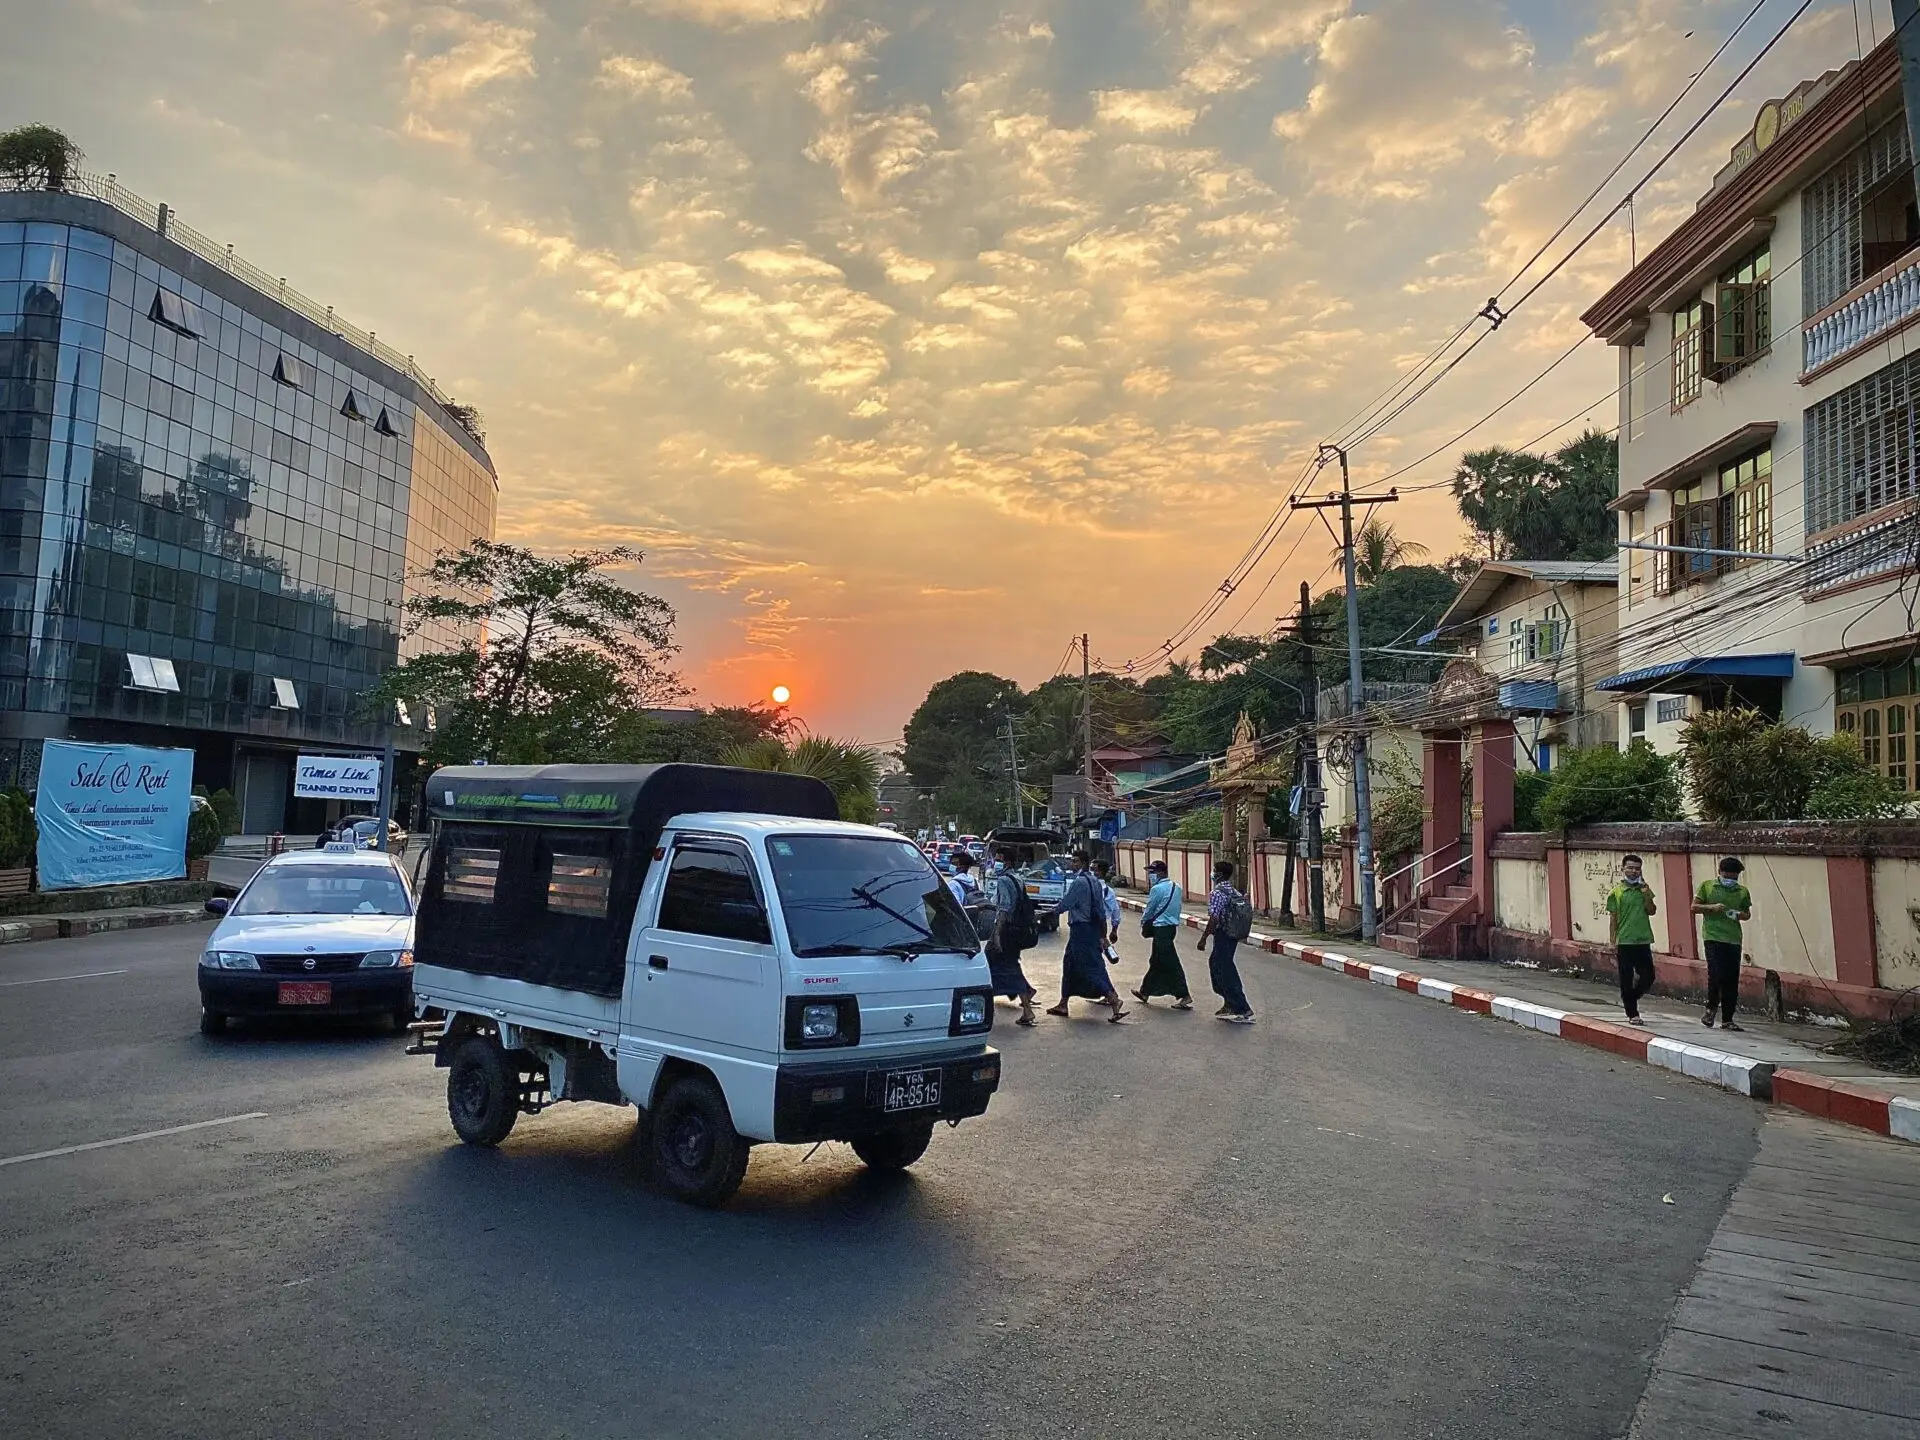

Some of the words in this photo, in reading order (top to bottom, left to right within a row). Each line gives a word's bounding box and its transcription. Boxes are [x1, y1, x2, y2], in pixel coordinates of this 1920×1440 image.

[70, 752, 112, 788] Sale
[135, 765, 170, 794] Rent
[301, 764, 337, 779] Times
[340, 767, 374, 780] Link
[297, 783, 337, 793] TRAINING
[340, 786, 375, 795] CENTER
[906, 1073, 924, 1084] YGN
[887, 1082, 938, 1108] 4R-8515
